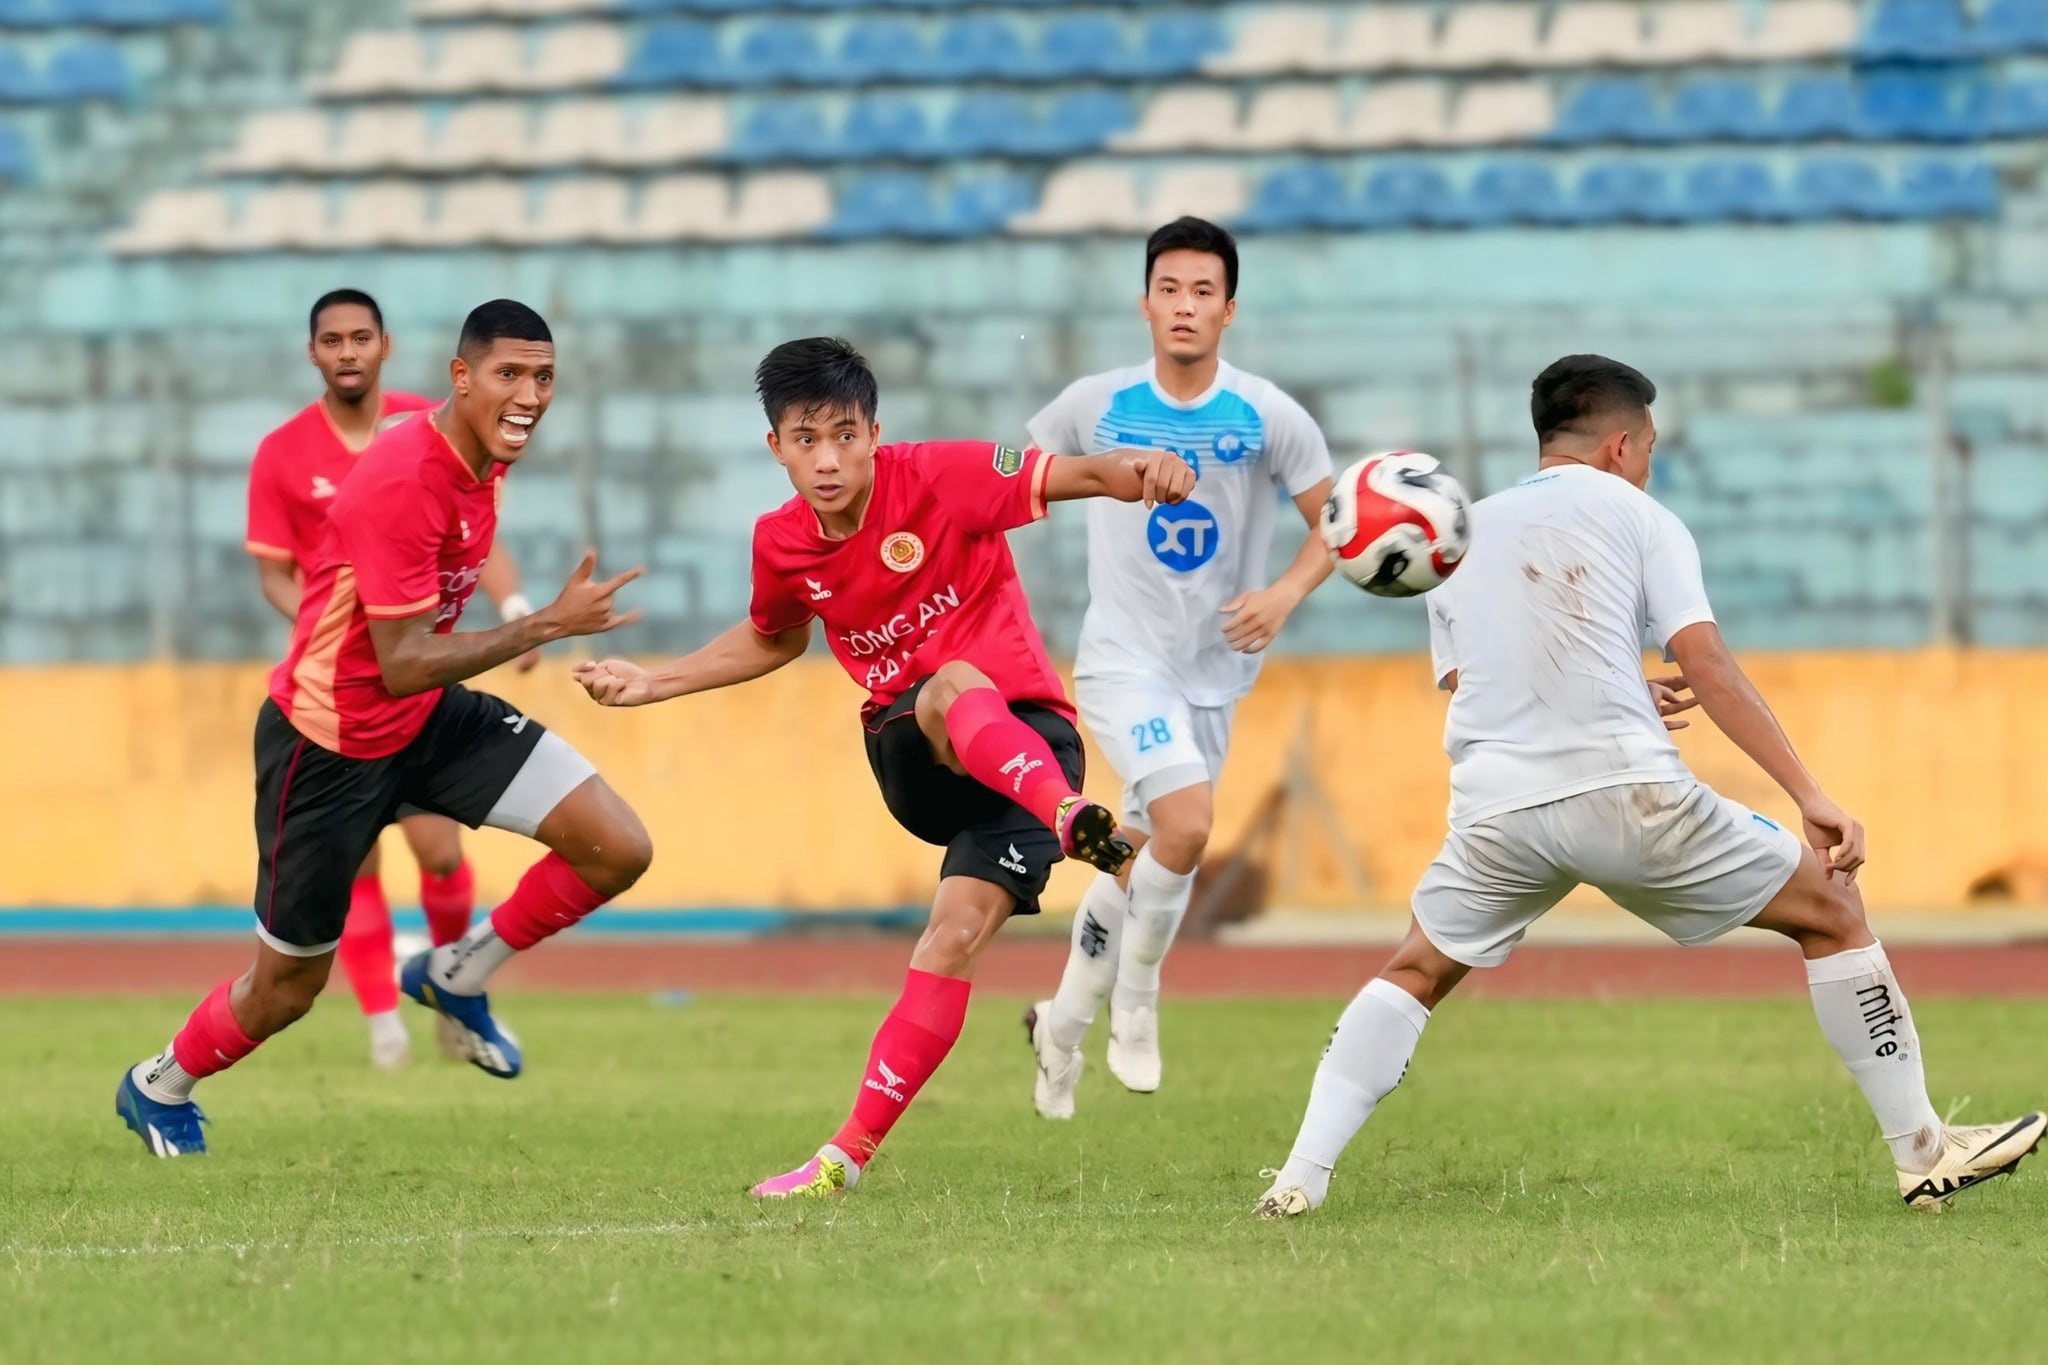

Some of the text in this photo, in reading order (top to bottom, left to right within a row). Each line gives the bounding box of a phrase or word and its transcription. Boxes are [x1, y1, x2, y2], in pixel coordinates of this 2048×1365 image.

[1156, 515, 1214, 557] XT
[918, 583, 961, 629] AN
[1131, 717, 1172, 753] 28
[1856, 984, 1904, 1057] mitre
